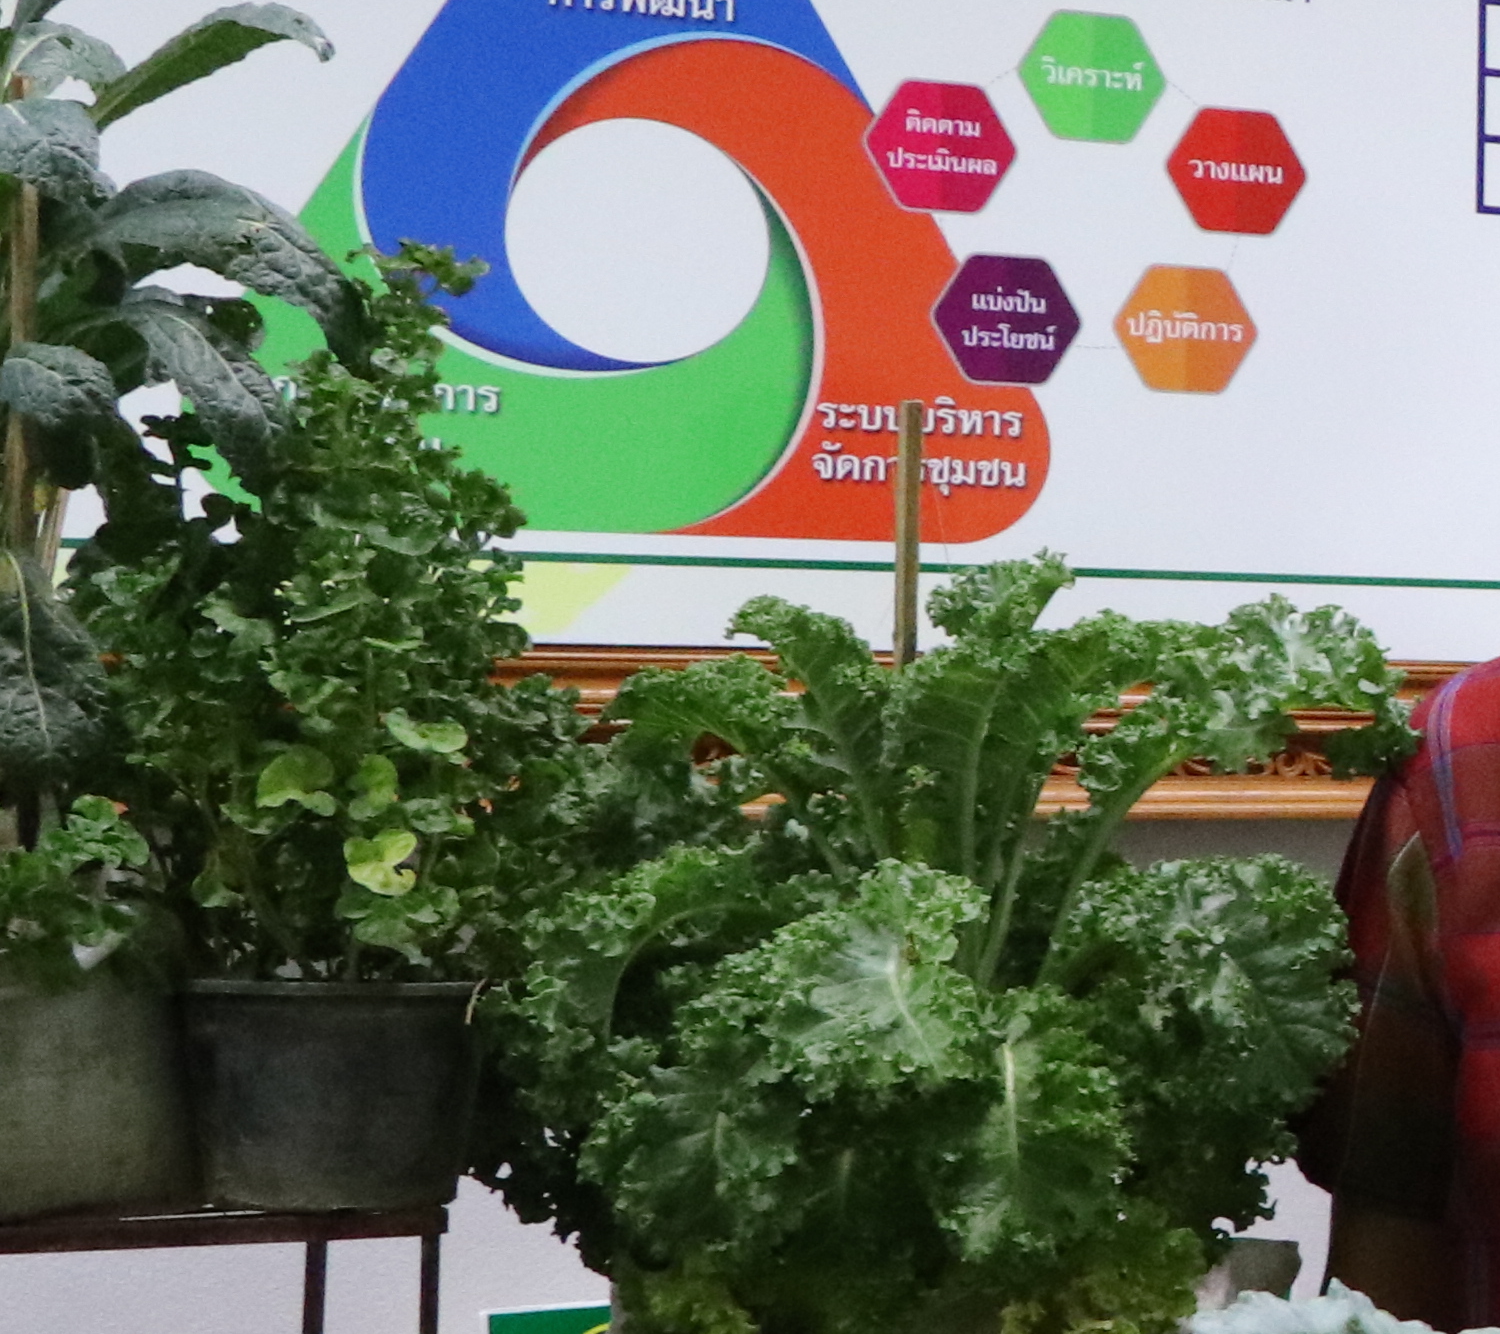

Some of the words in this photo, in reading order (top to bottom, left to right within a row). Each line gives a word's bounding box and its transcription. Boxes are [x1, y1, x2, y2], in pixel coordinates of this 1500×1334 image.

[905, 108, 981, 139] ติดตาม
[886, 147, 998, 177] ประเมินผล
[1188, 157, 1284, 185] วางแผน
[971, 285, 1047, 315] แบ่งปัน
[961, 323, 1058, 352] ประโยชน์
